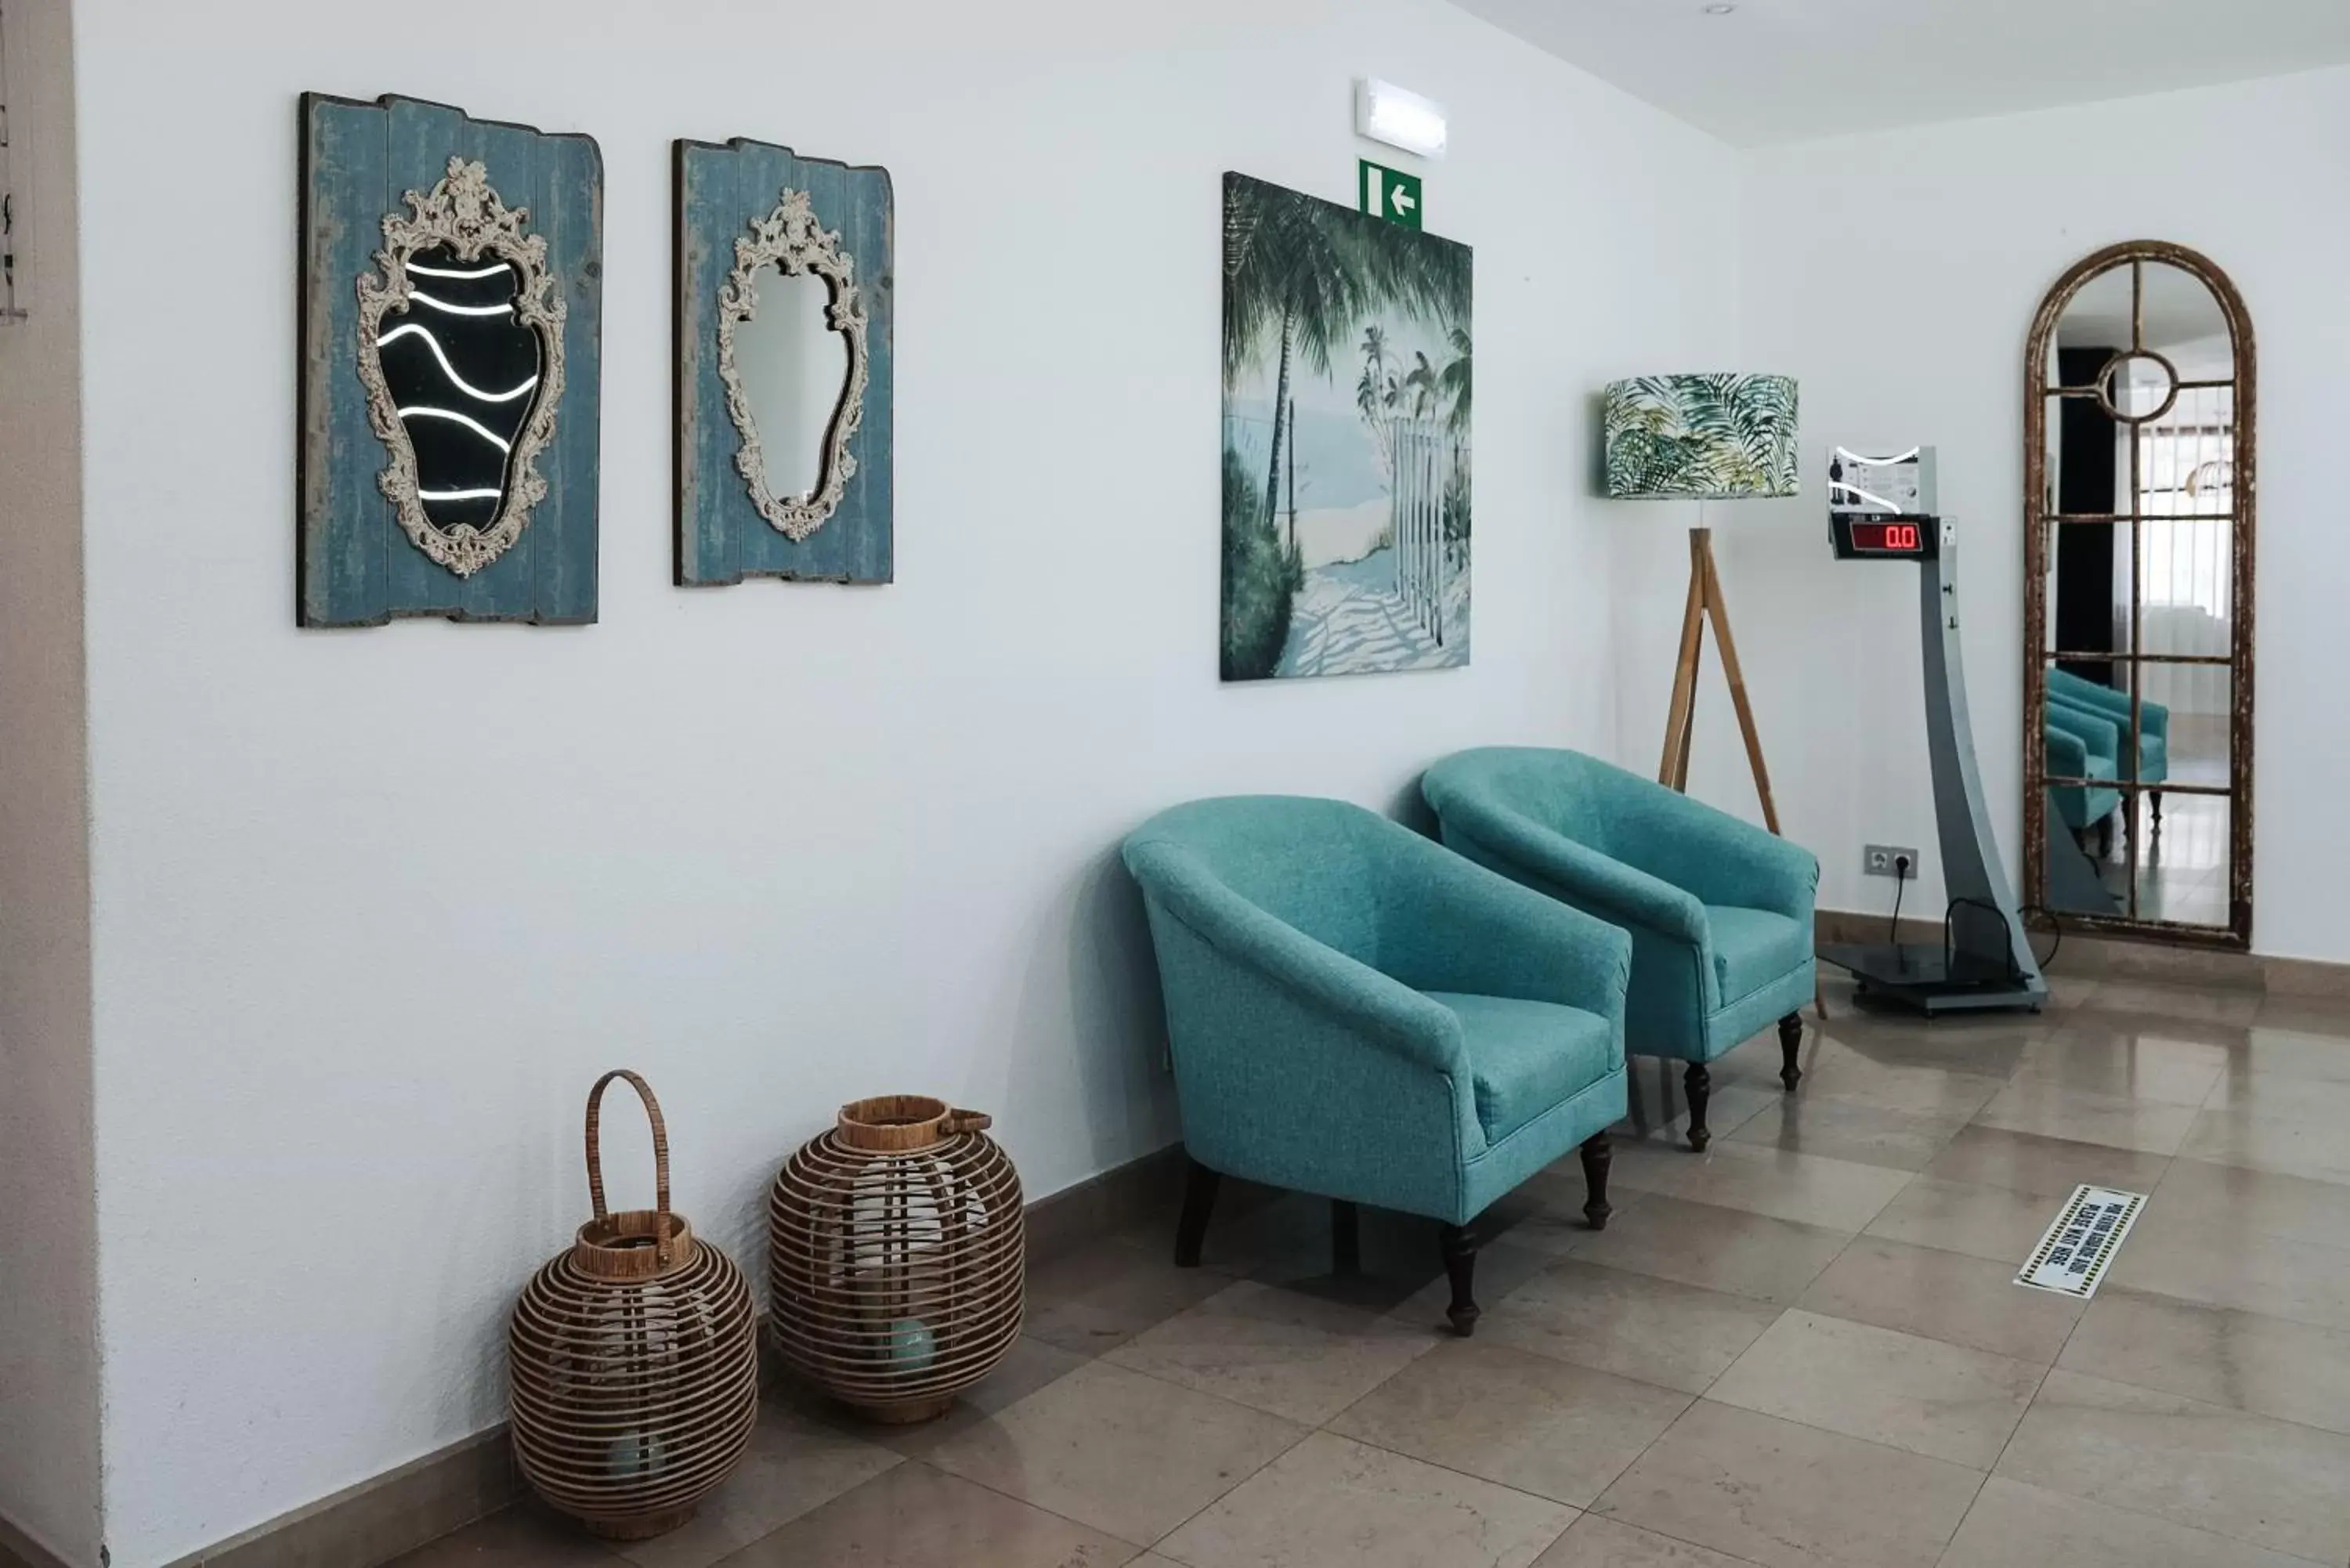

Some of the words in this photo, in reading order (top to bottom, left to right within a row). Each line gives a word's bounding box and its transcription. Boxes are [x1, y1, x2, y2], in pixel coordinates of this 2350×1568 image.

[1886, 526, 1915, 547] 0.0
[2070, 1203, 2102, 1228] PLEASE
[2059, 1227, 2086, 1247] WAIT
